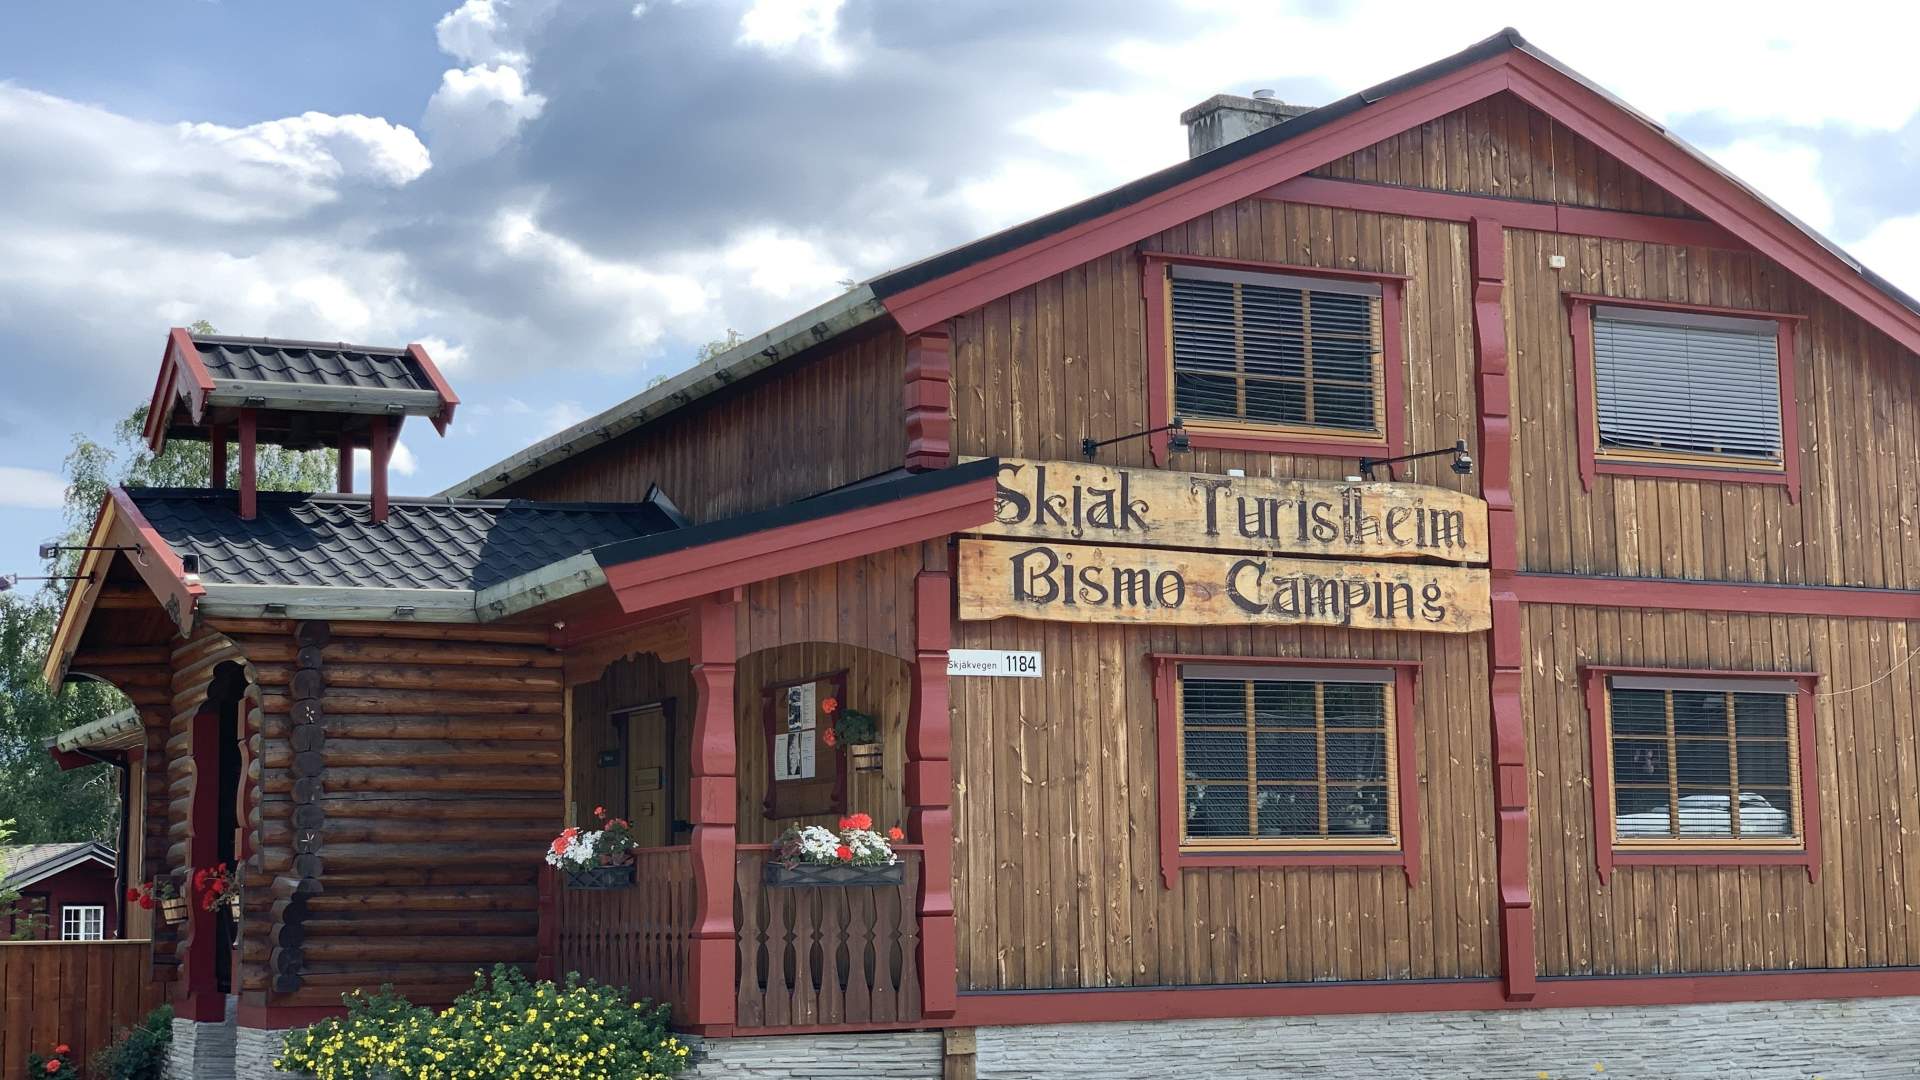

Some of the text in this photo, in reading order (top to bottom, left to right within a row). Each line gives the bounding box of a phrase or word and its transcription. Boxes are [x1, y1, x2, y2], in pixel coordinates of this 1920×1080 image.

[1190, 476, 1468, 549] Turistheim
[1009, 546, 1446, 627] Bismo Camping
[1006, 655, 1037, 673] 1184
